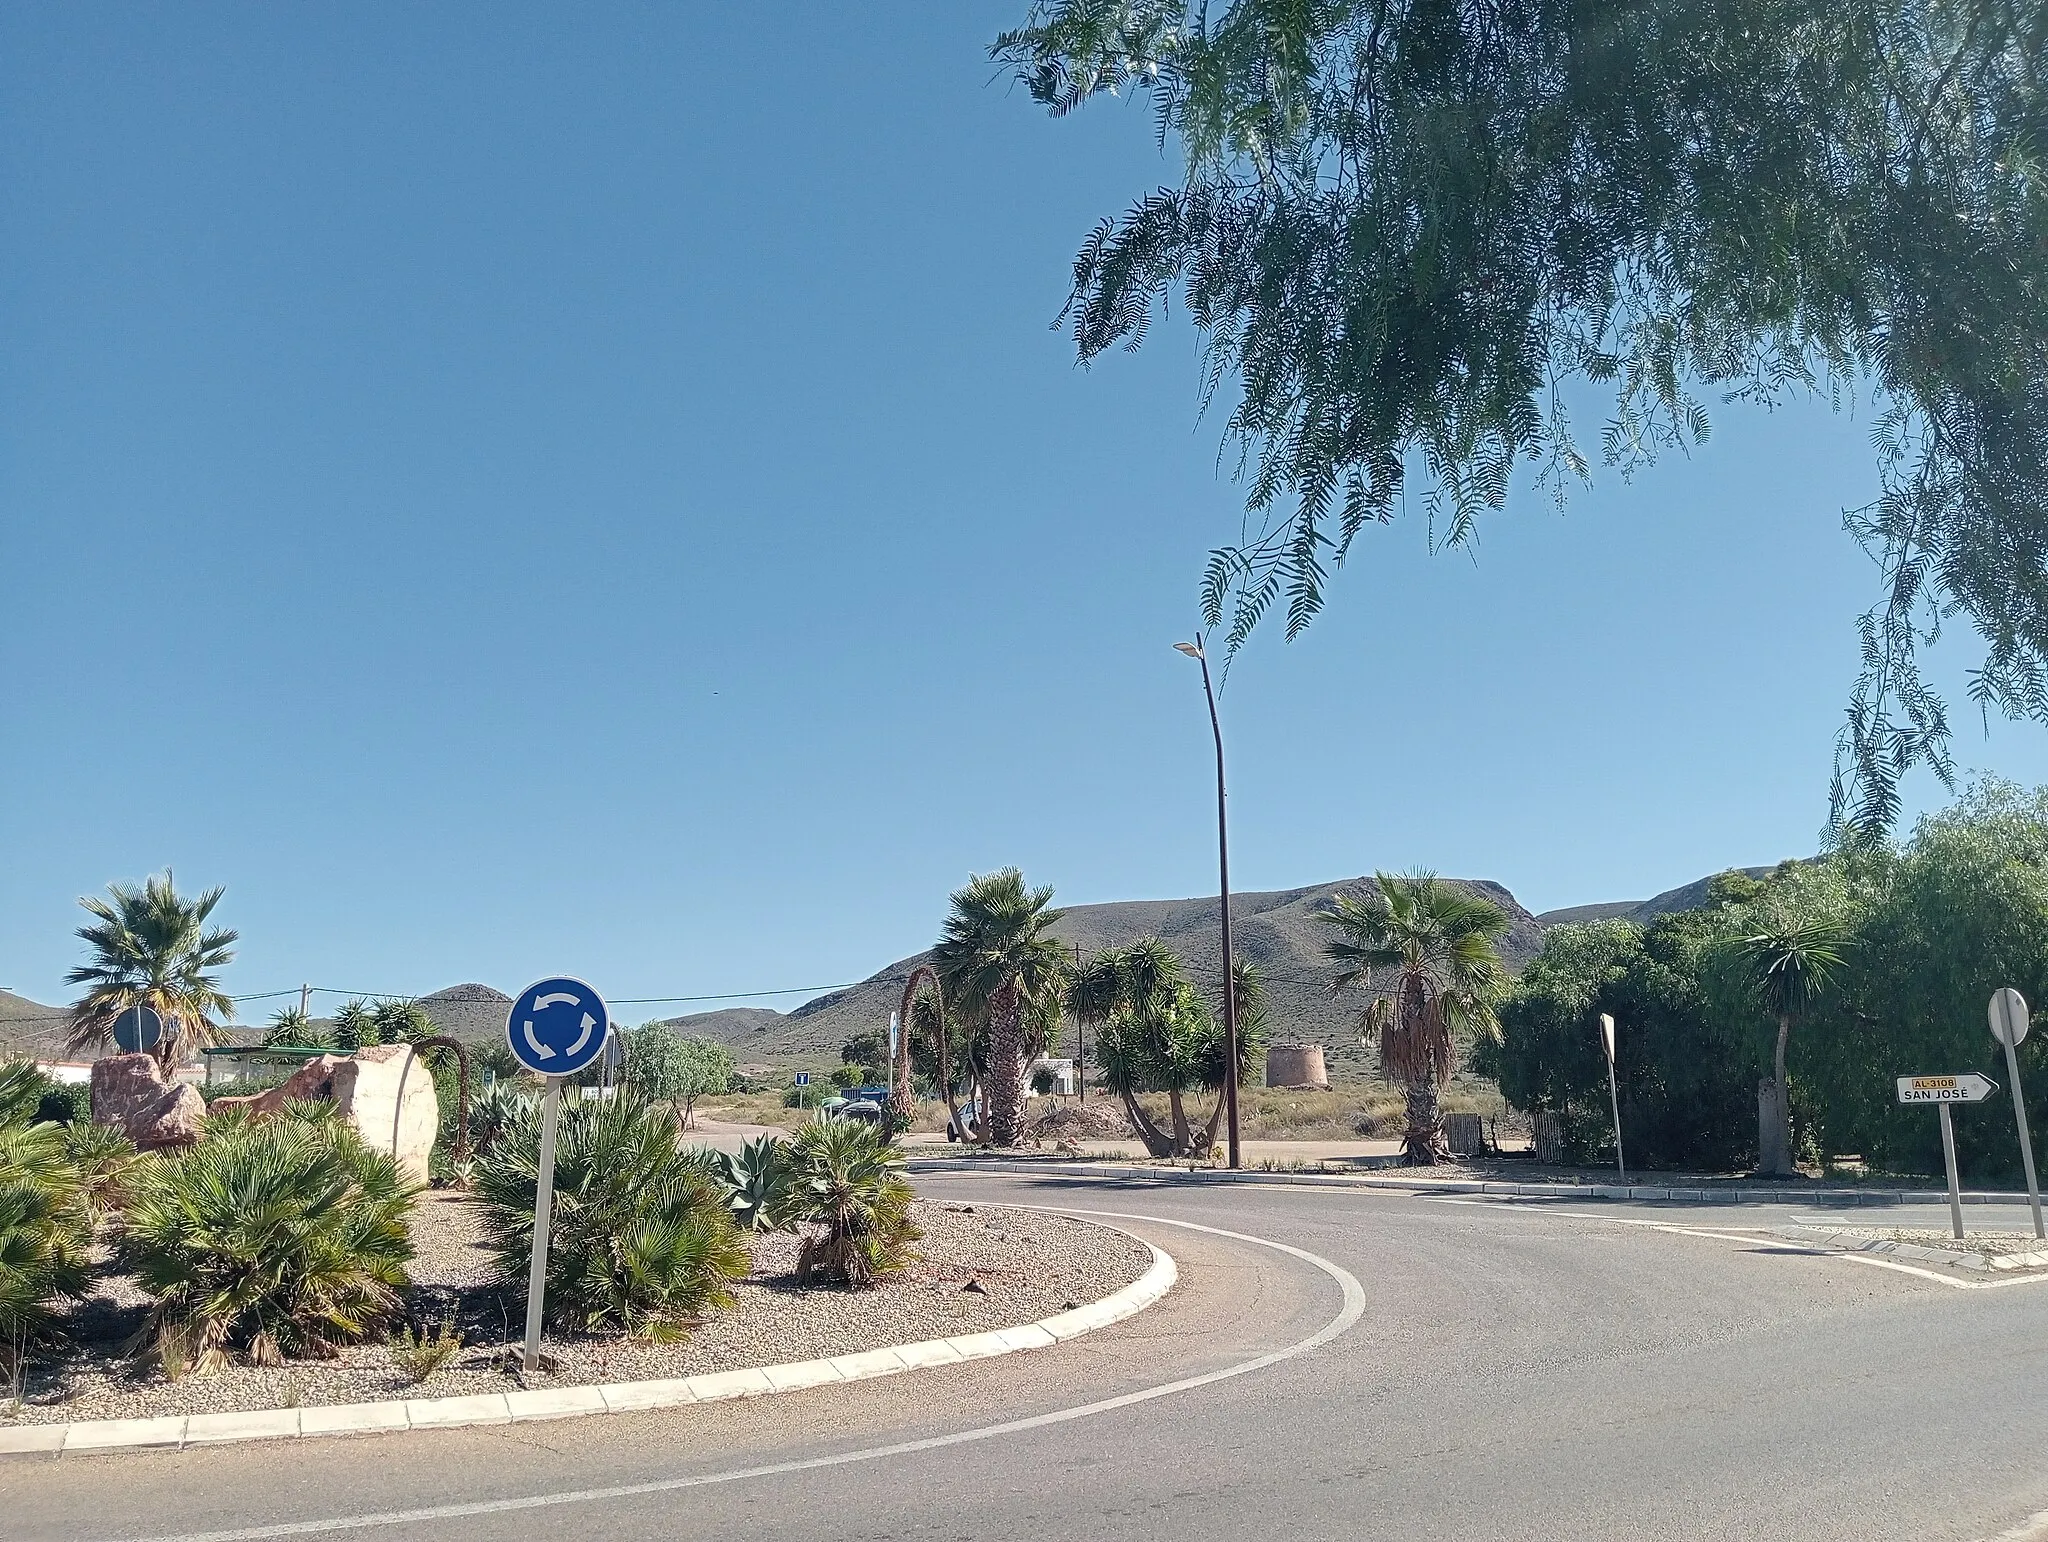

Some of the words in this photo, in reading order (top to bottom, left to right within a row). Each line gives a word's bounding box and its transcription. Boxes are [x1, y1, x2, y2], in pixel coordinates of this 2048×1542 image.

[1914, 1079, 1954, 1088] AL-3108
[1904, 1090, 1931, 1100] SAN
[1936, 1087, 1969, 1099] JOSÉ
